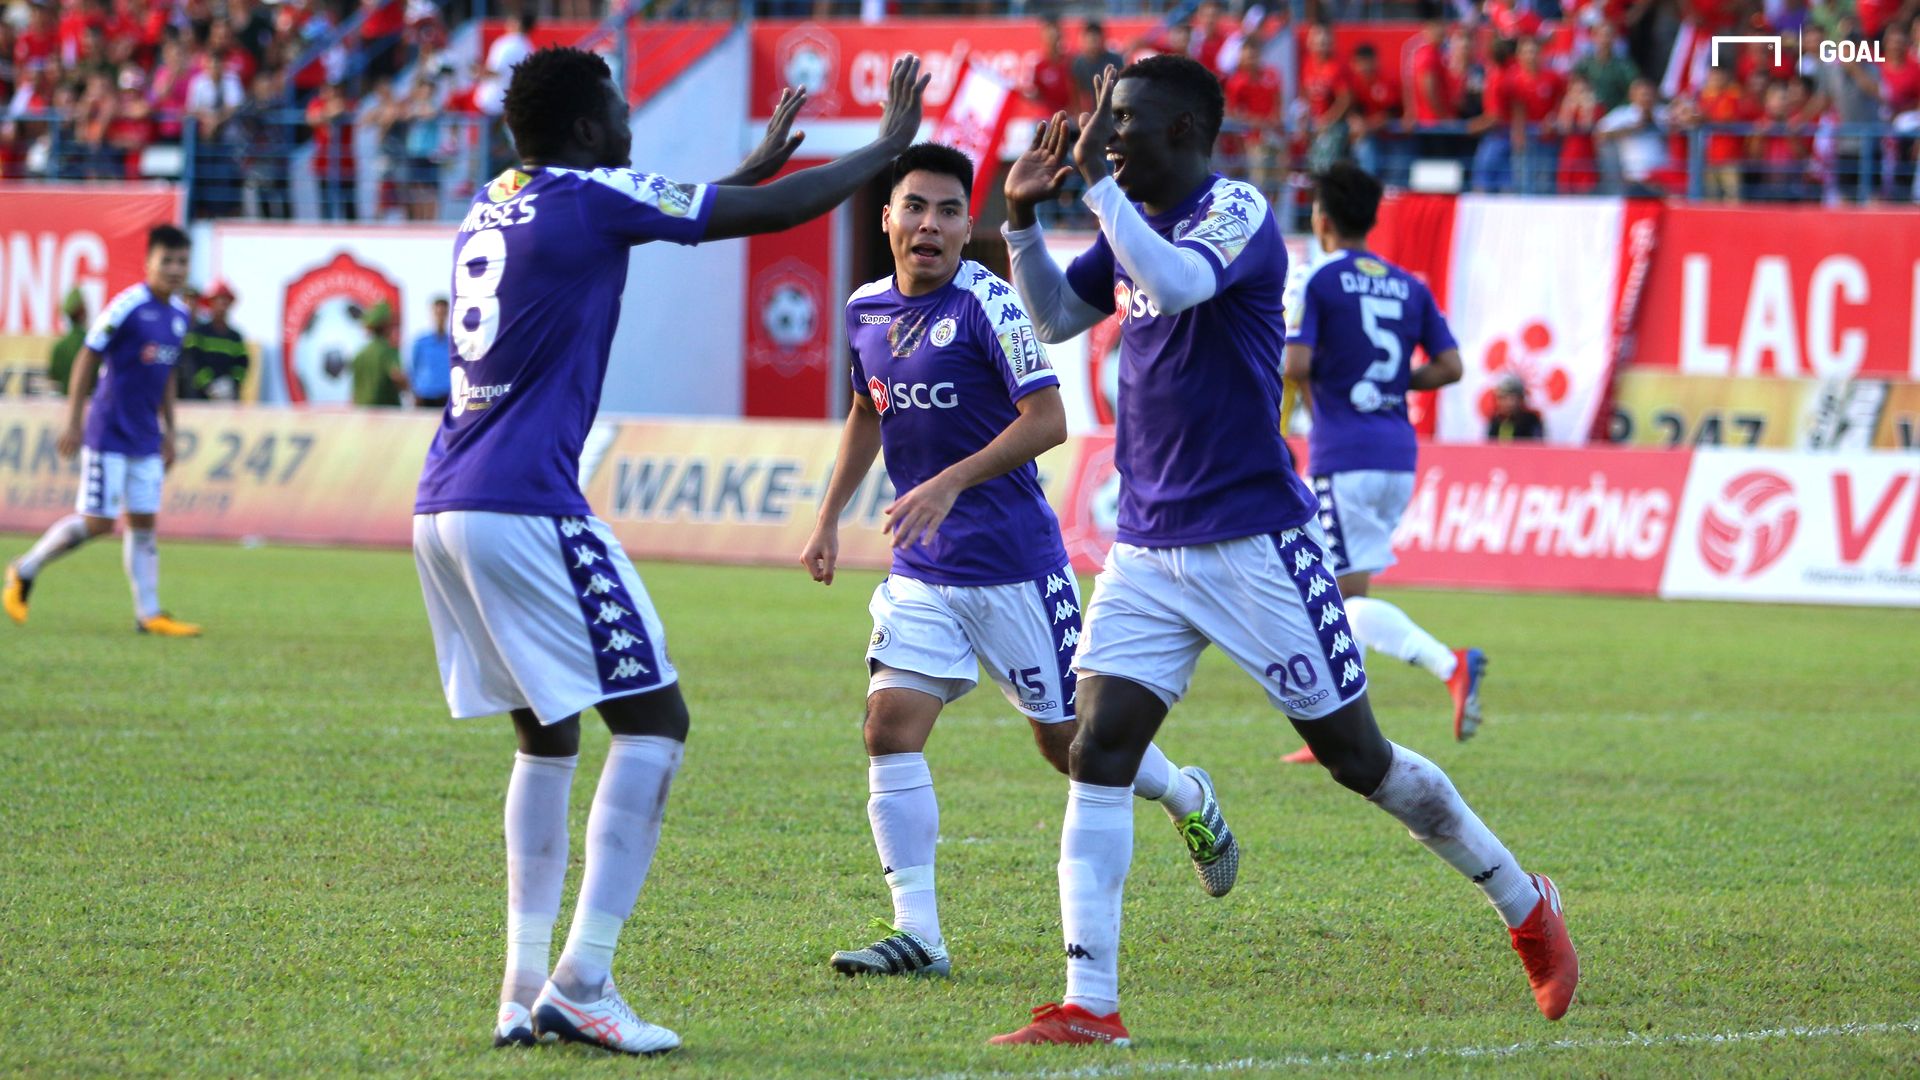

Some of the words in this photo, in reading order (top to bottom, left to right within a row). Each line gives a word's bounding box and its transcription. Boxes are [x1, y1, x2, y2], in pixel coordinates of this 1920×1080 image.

[458, 193, 540, 232] MOSES
[452, 229, 507, 361] 8
[860, 314, 891, 324] Kappa
[1360, 295, 1403, 383] 5
[893, 382, 959, 409] SCG
[207, 432, 316, 485] 247
[1009, 666, 1046, 701] 15
[1265, 653, 1317, 697] 20
[1069, 1025, 1112, 1040] NEMESIS
